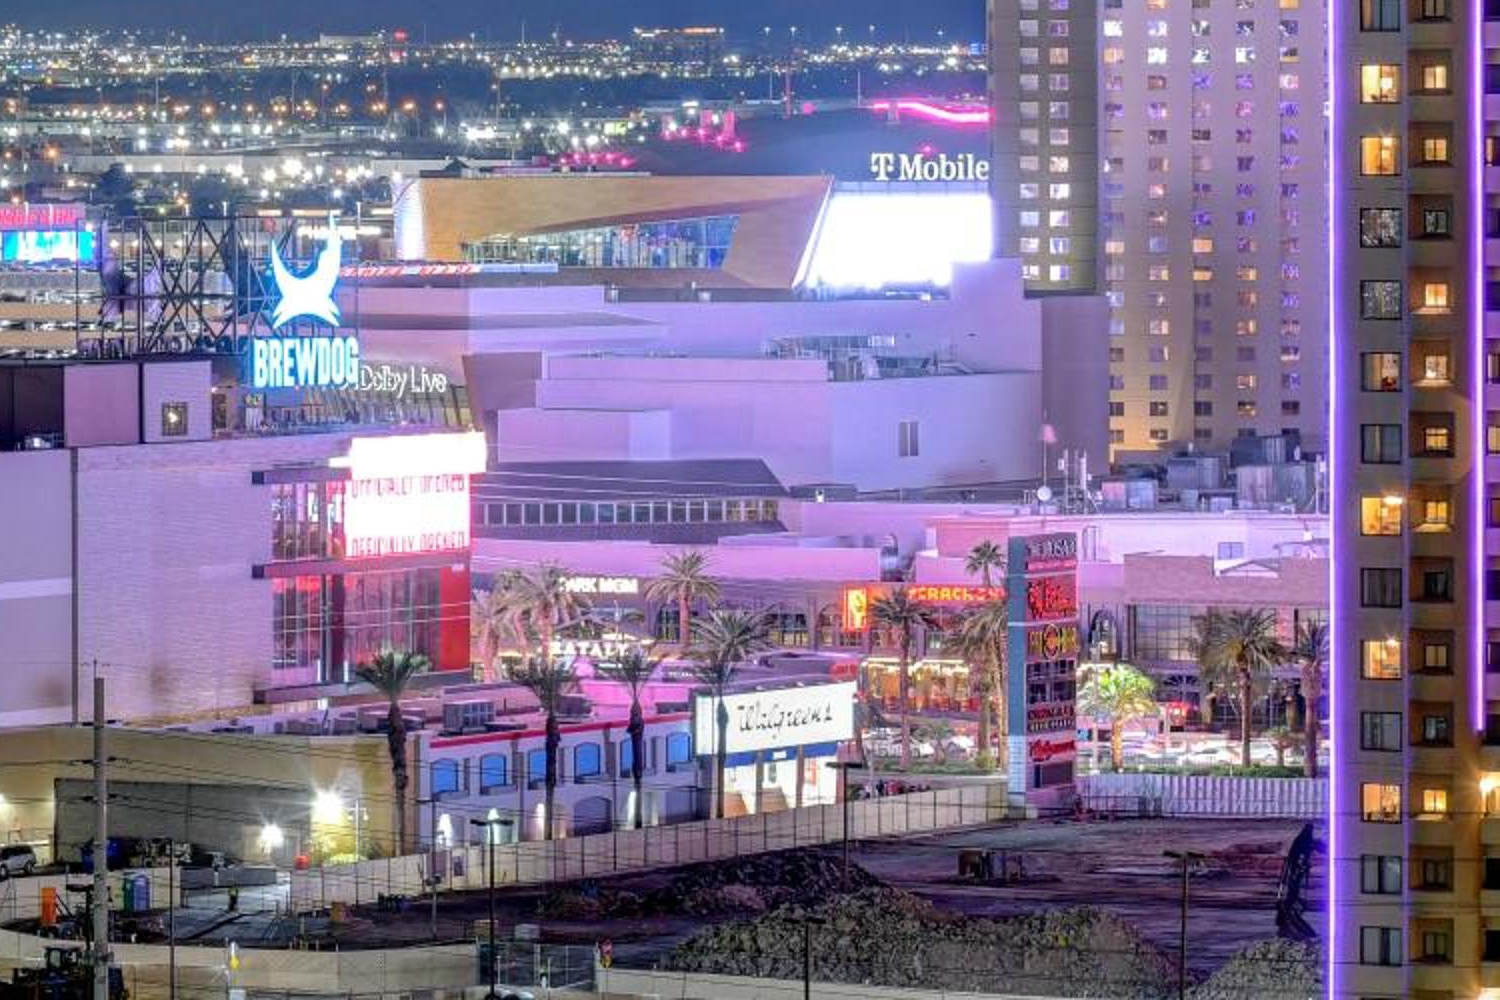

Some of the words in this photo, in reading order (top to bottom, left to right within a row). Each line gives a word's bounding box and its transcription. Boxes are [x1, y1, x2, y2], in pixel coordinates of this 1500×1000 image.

[898, 152, 989, 181] Mobile
[253, 336, 359, 388] BREWDOG
[360, 364, 408, 399] Dolby
[411, 364, 448, 393] Live
